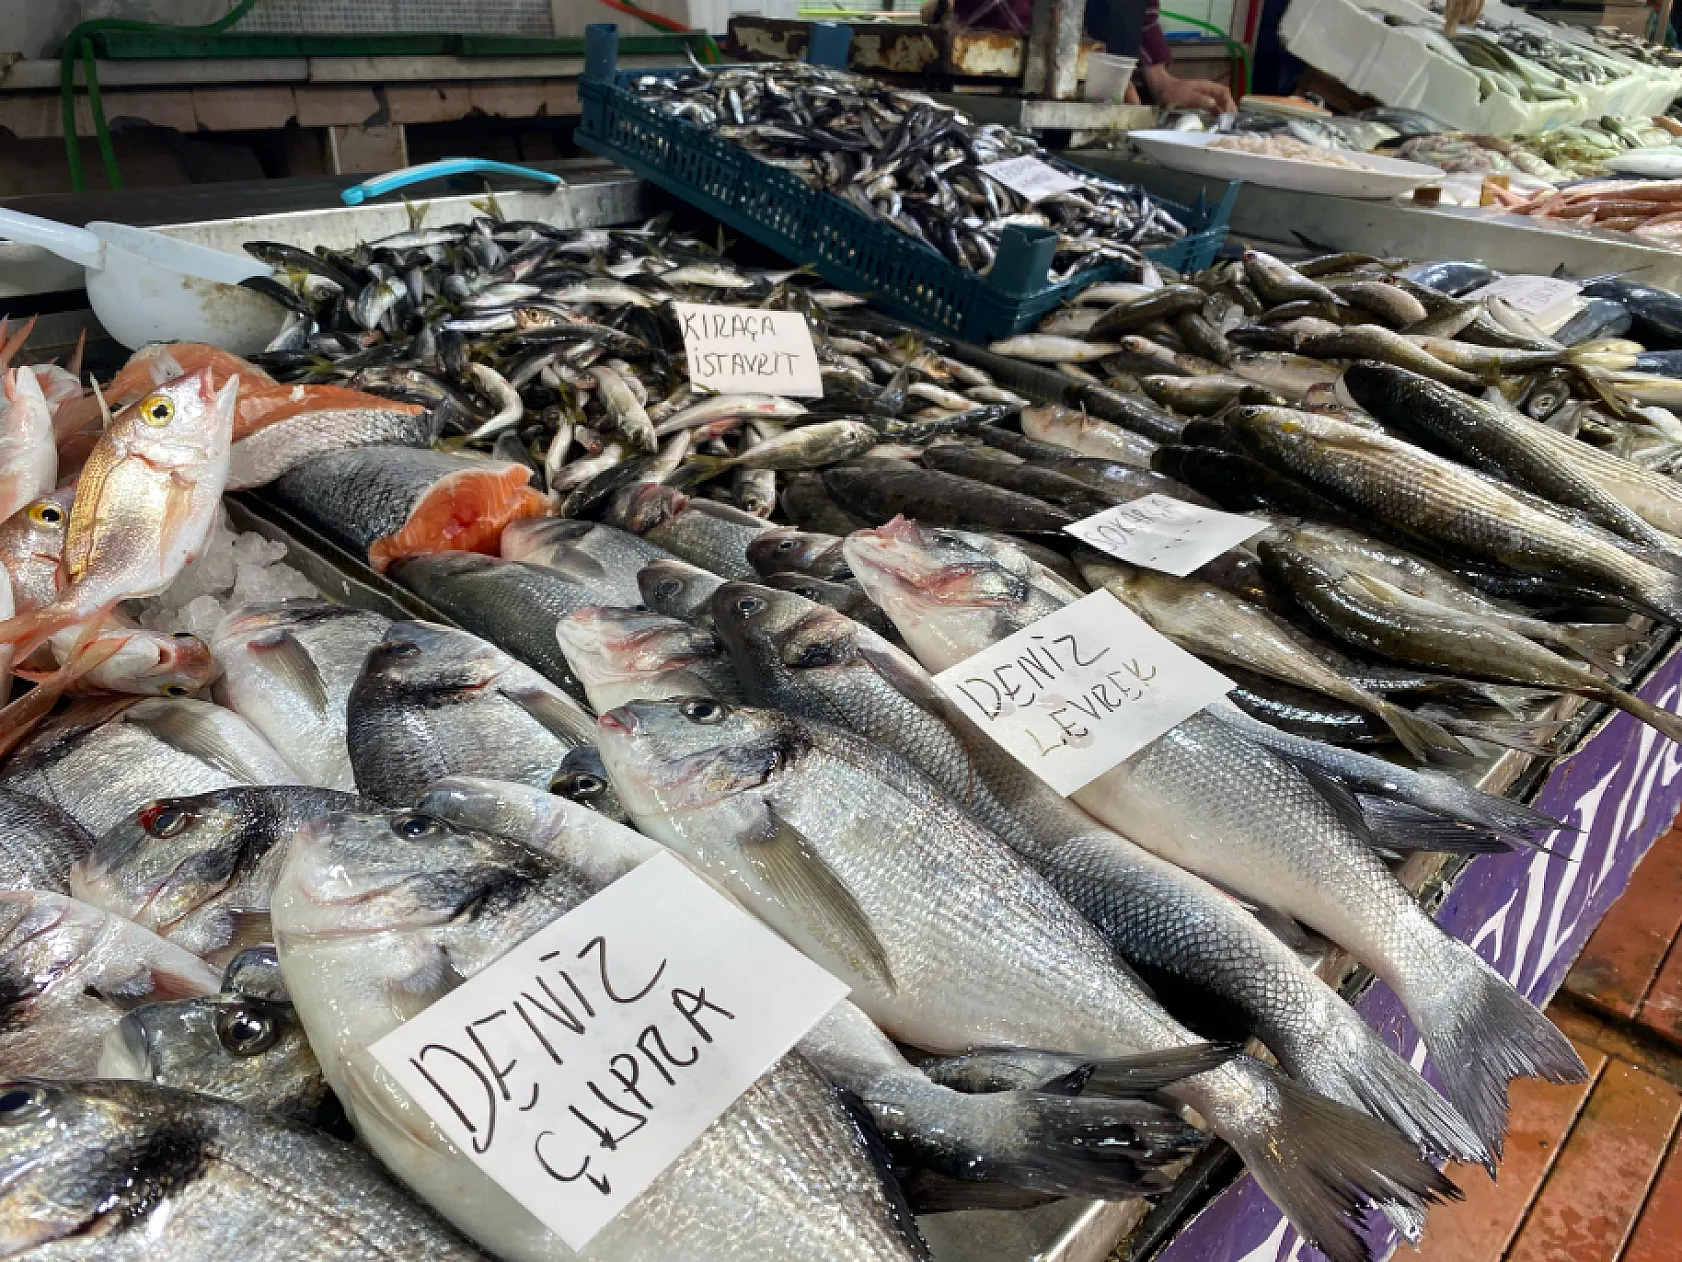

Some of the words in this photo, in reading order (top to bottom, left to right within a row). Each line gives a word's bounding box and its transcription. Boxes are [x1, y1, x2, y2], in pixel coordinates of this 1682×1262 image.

[683, 312, 777, 343] KIRAÇA
[955, 633, 1111, 722] DENİZ
[1024, 657, 1157, 757] LEVREK
[409, 935, 667, 1154] DENİZ
[534, 985, 736, 1196] ÇUPRA
